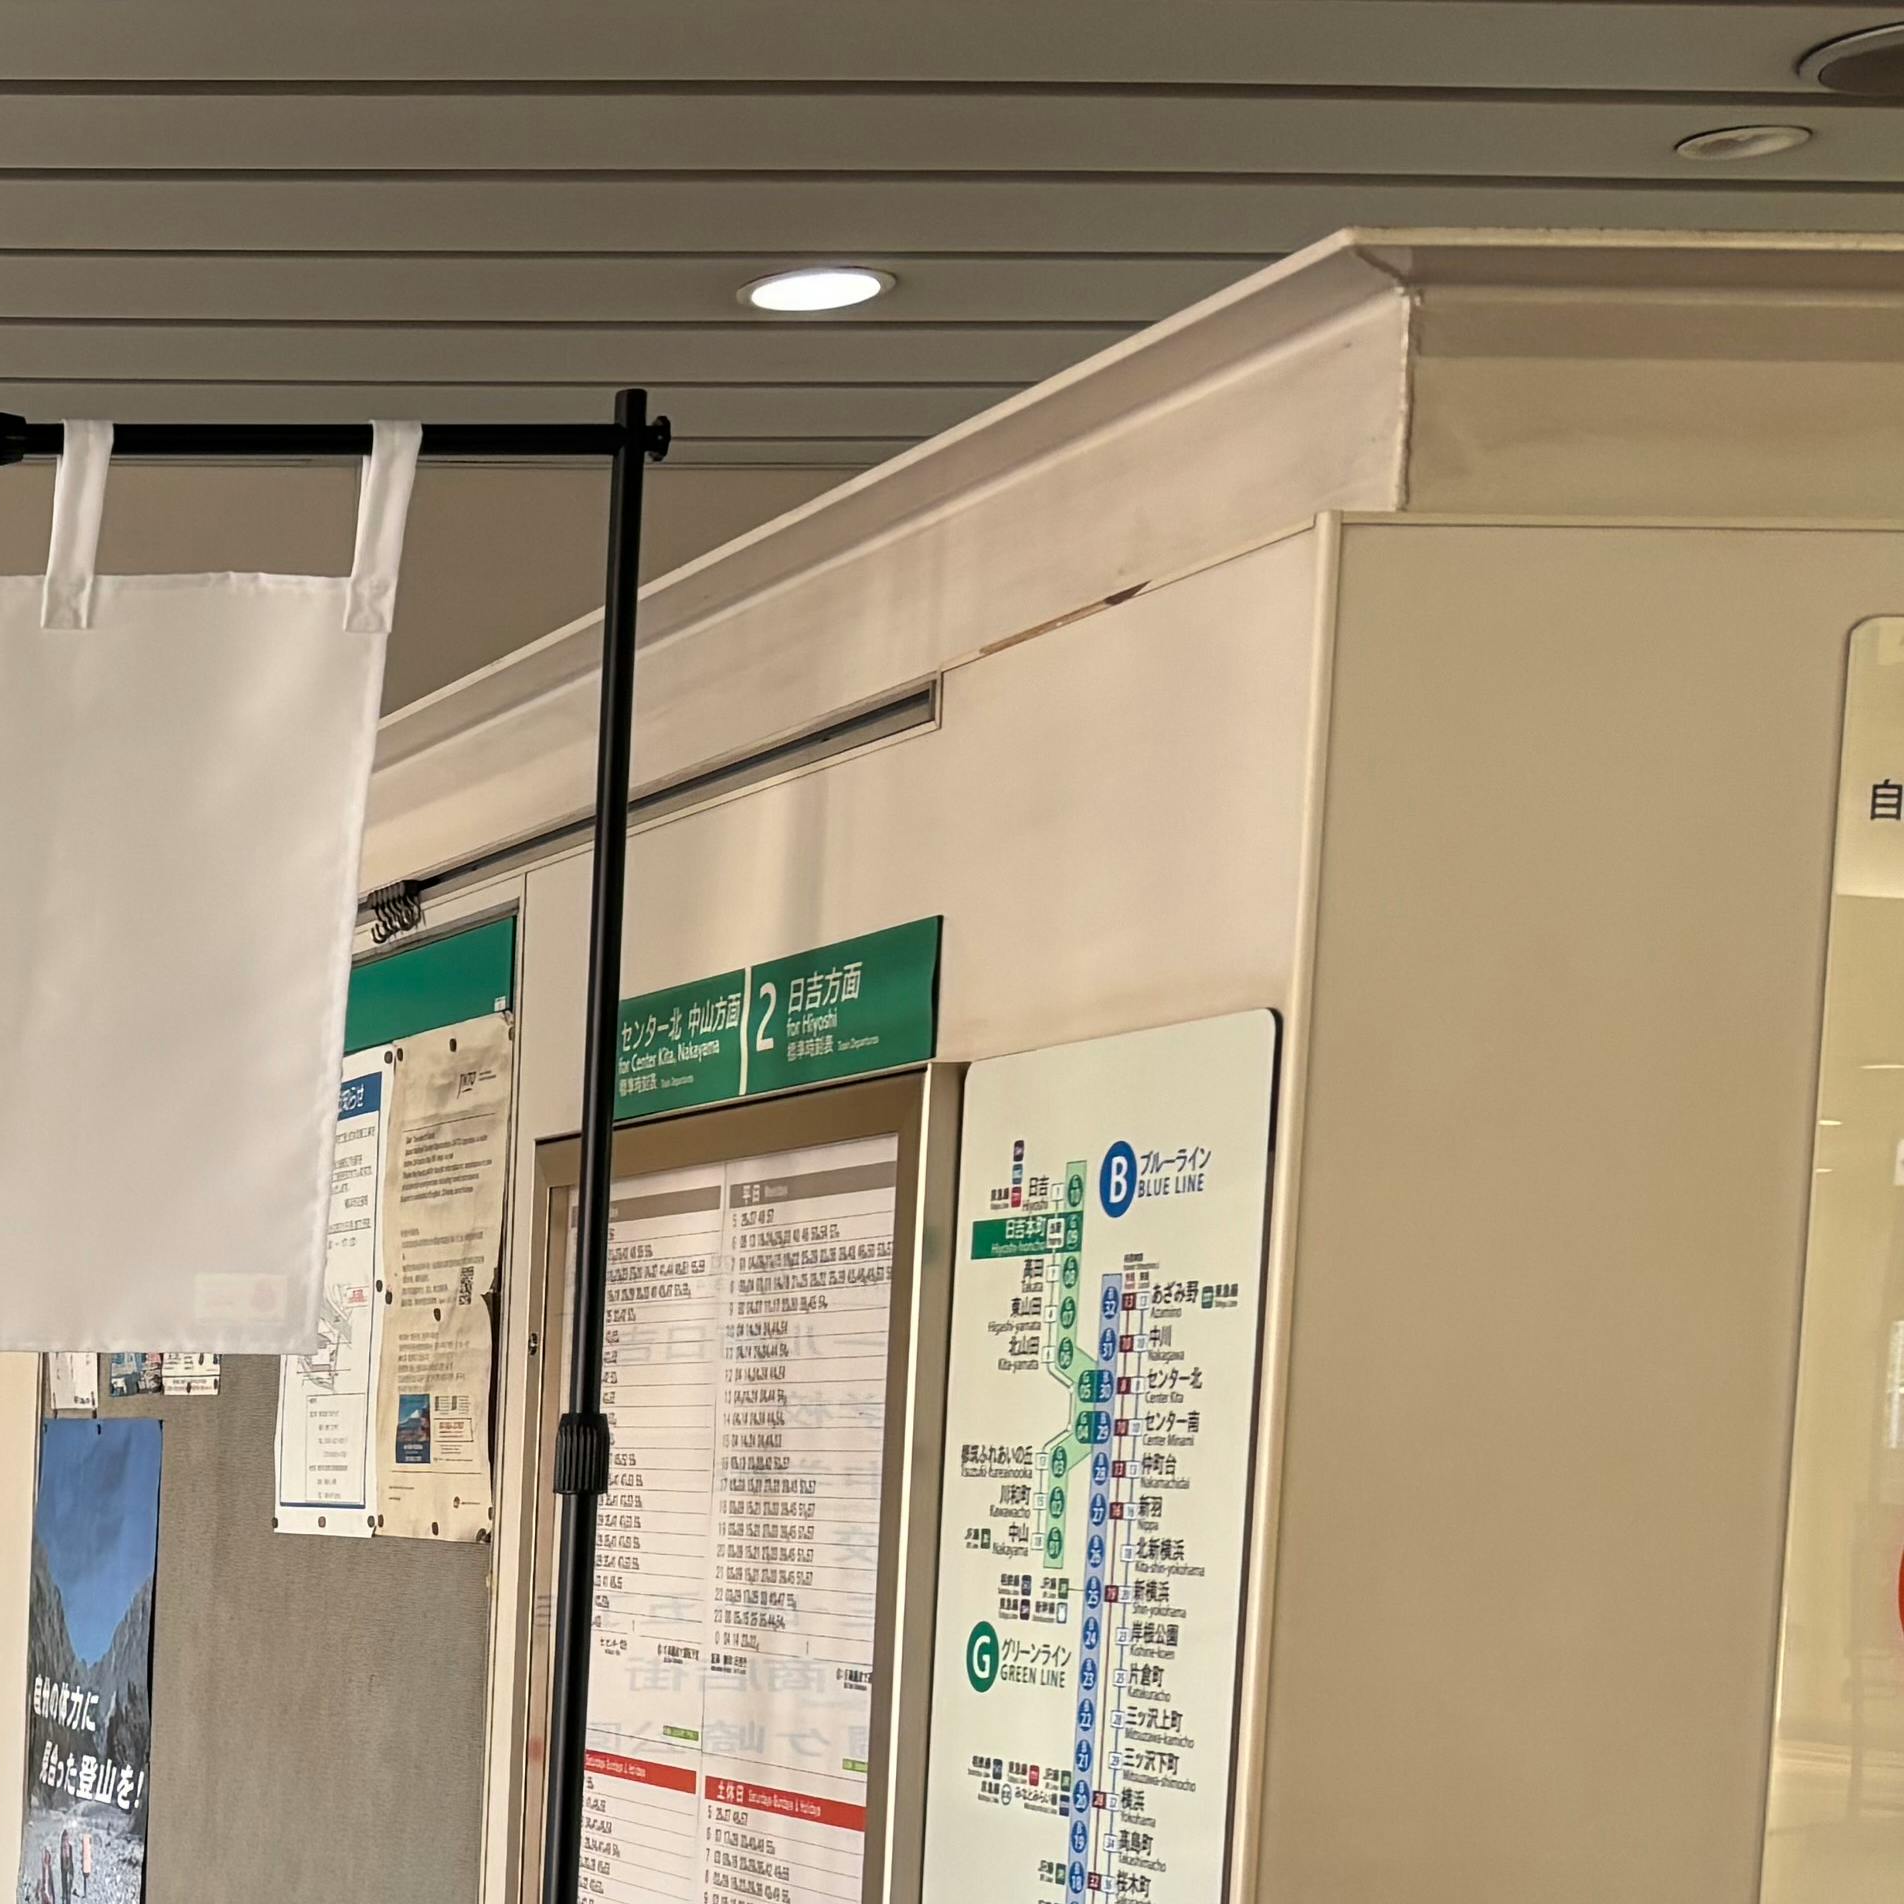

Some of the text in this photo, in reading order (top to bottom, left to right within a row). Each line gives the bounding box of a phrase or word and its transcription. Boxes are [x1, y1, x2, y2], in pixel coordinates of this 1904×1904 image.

[1870, 778, 1904, 820] 自
[788, 961, 863, 1014] 日吉方面
[621, 993, 741, 1052] センター北 中山方面
[756, 982, 777, 1051] 2
[802, 1009, 838, 1035] Hiyoshi
[678, 1040, 720, 1063] Nakayama
[1139, 1147, 1211, 1176] ブルーライン
[1138, 1173, 1204, 1198] BLUE LINE
[1147, 1368, 1203, 1391] センター北
[1001, 1638, 1072, 1666] グリーンライン
[1000, 1665, 1066, 1689] GREEN LINE
